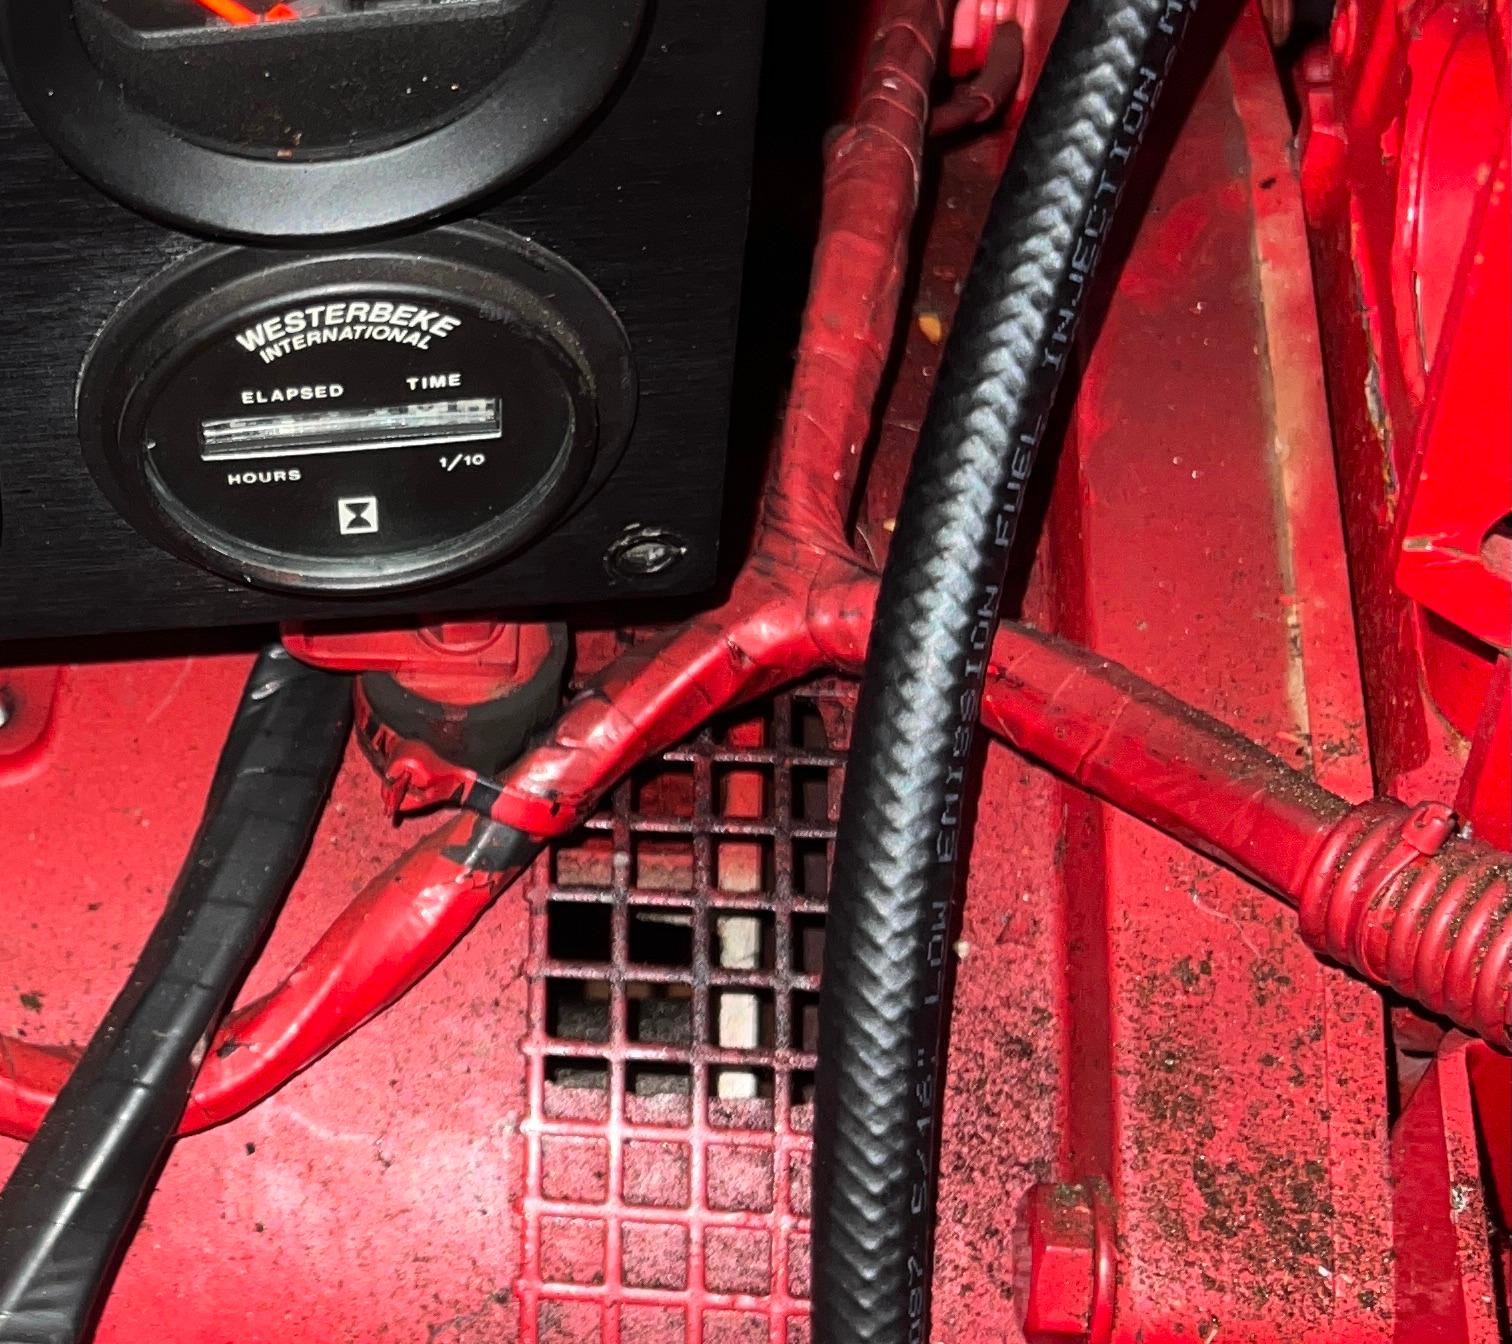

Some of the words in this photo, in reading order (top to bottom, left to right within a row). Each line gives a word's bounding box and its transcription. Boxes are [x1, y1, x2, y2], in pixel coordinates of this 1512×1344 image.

[235, 302, 461, 353] WESTERBEKE
[259, 325, 432, 364] INTERNATIONAL
[241, 384, 344, 405] ELAPSED
[406, 373, 462, 391] TIME
[228, 469, 302, 486] HOURS
[439, 453, 485, 471] 1/10
[924, 899, 950, 1006] LOW
[937, 583, 1000, 863] EMISSION
[994, 413, 1046, 547] FUEL
[1046, 67, 1158, 369] INJECTION
